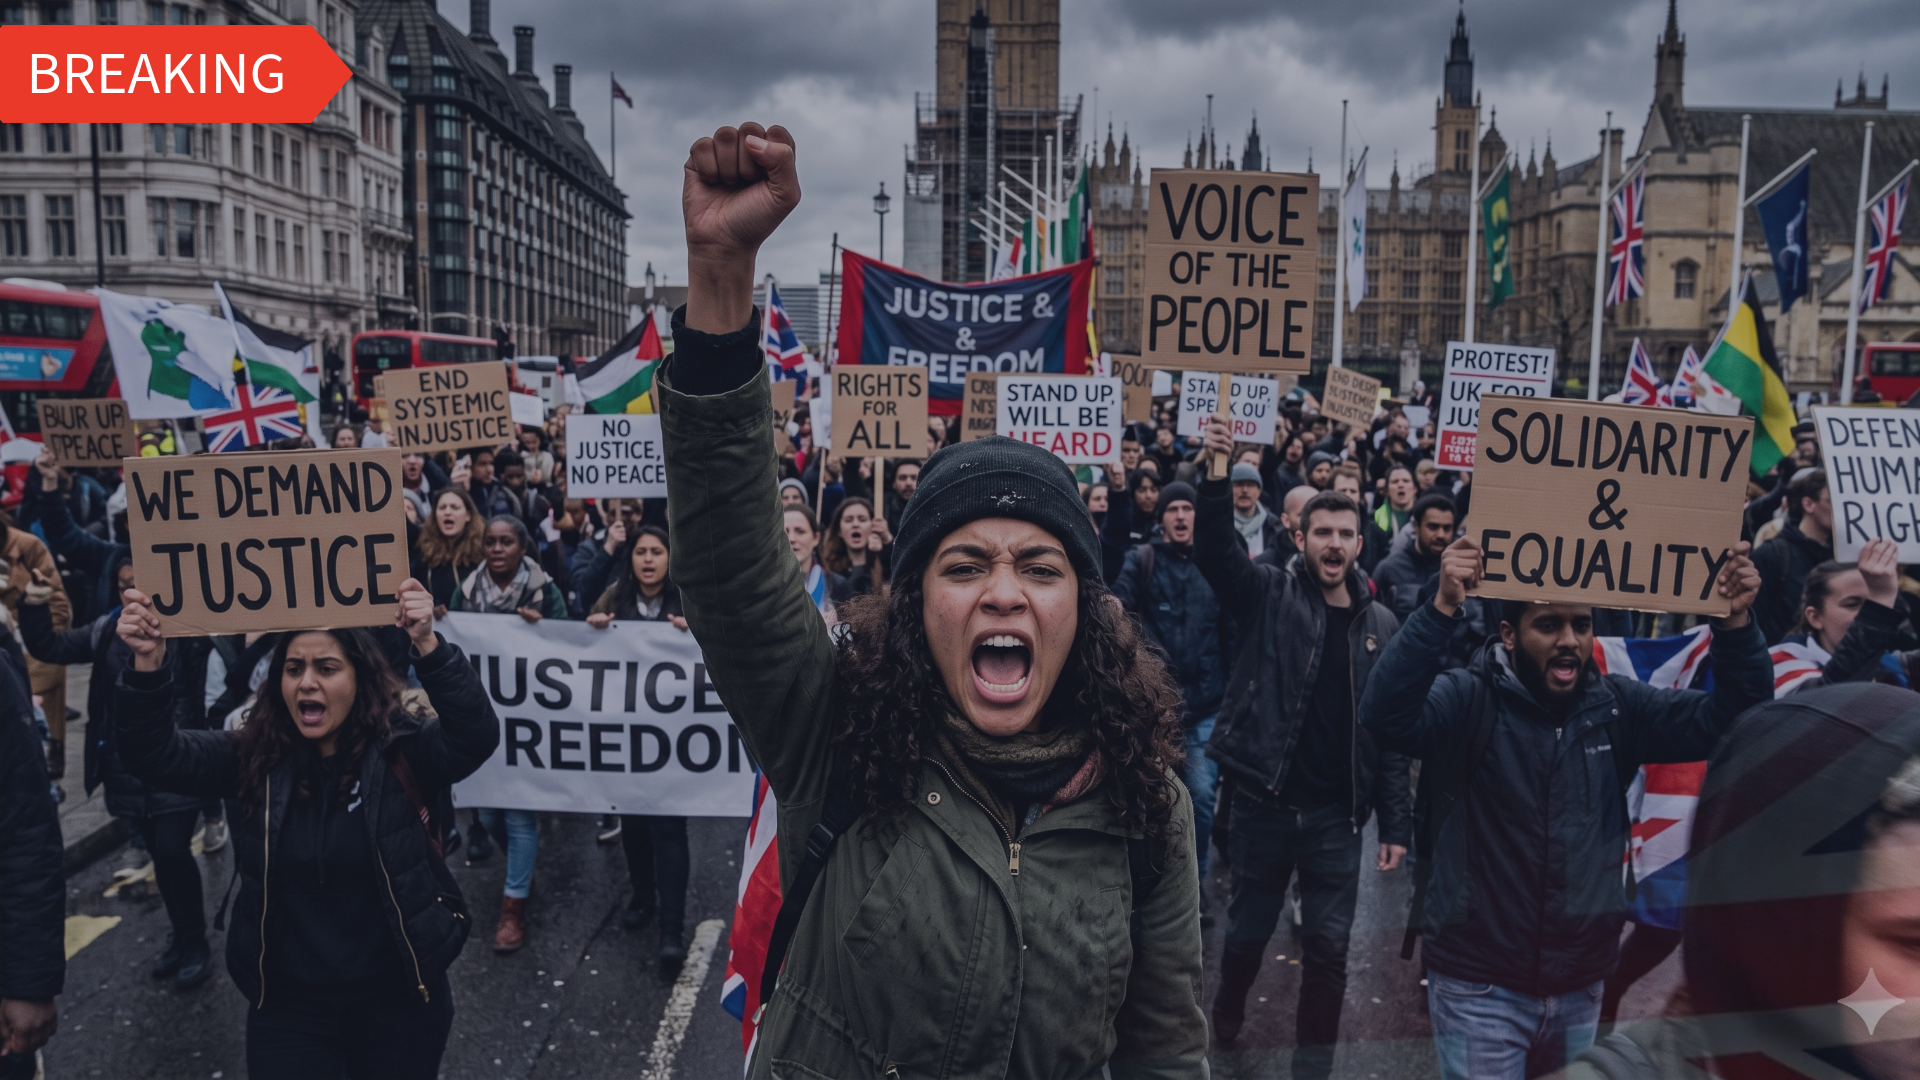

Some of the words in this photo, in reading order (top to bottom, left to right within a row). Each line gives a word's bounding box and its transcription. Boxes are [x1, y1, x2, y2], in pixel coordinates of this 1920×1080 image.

[1160, 182, 1308, 246] VOICE
[1169, 251, 1214, 285] OF
[1226, 252, 1291, 289] THE
[884, 286, 1024, 323] JUSTICE
[1032, 292, 1055, 319] &
[955, 327, 976, 351] &
[1149, 294, 1308, 359] PEOPLE
[1451, 349, 1549, 375] PROTEST!
[419, 369, 469, 393] END
[838, 372, 922, 398] RIGHTS
[1187, 378, 1242, 397] STAD
[1247, 384, 1271, 403] UP,
[1450, 381, 1482, 402] UK
[395, 390, 505, 420] SYSTEMIC
[1007, 383, 1078, 402] STAND
[1085, 384, 1115, 406] UP,
[1186, 398, 1237, 416] SPEK
[863, 401, 897, 416] FOR
[1008, 406, 1070, 427] WILL
[1078, 407, 1109, 427] BE
[397, 416, 509, 447] INJUSTICE
[602, 419, 631, 437] NO
[847, 420, 911, 450] ALL
[1197, 416, 1257, 436] HRD
[575, 441, 661, 462] JUSTICE,
[1485, 408, 1750, 483] SOLIDARITY
[572, 465, 599, 484] NO
[605, 464, 666, 484] PEACE
[1832, 455, 1920, 495] HUM
[131, 468, 200, 522] WE
[214, 461, 393, 519] DEMAND
[1589, 478, 1628, 531] &
[150, 533, 399, 616] JUSTICE
[1482, 529, 1730, 601] EQUALITY
